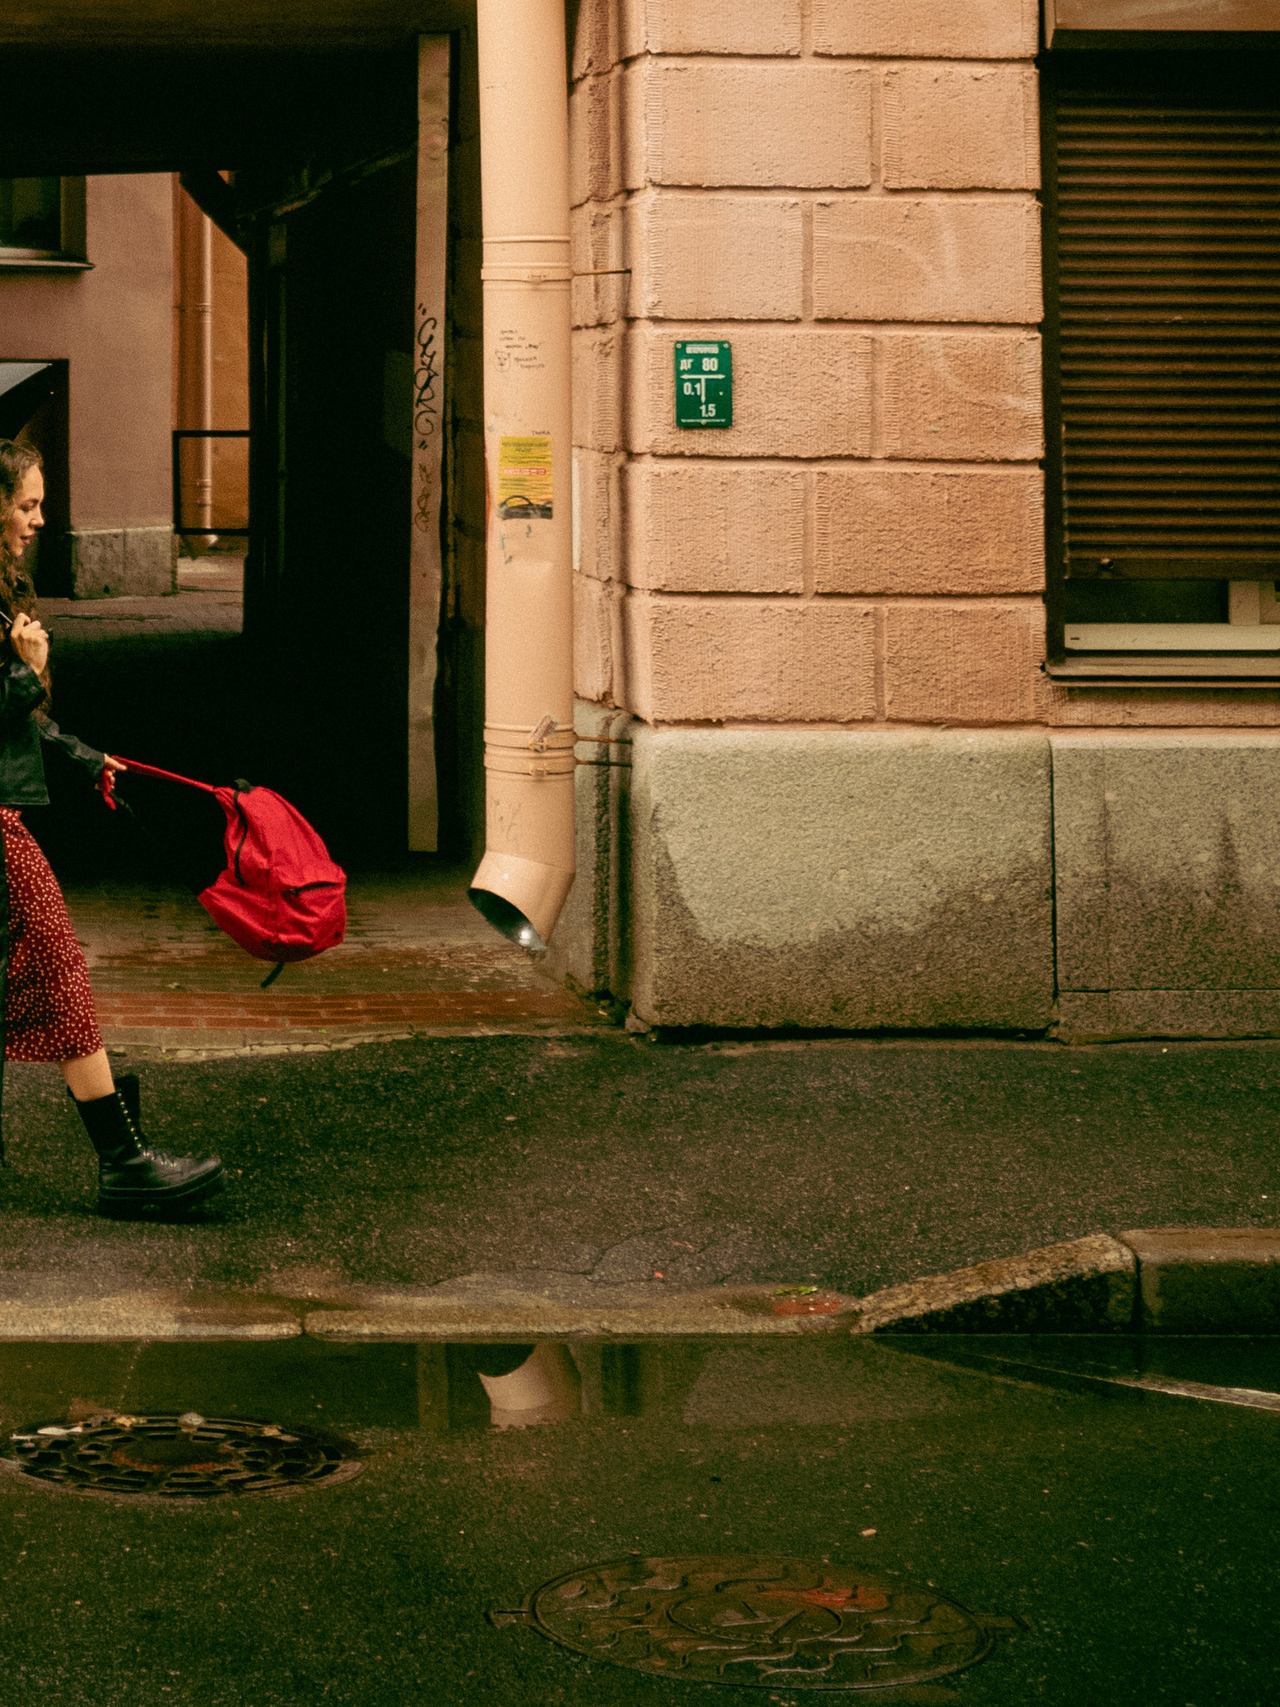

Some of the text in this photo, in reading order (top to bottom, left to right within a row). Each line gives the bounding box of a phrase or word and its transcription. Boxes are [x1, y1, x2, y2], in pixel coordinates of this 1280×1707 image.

[702, 357, 719, 371] 80
[683, 382, 701, 396] 0.1
[699, 403, 716, 418] 1.5
